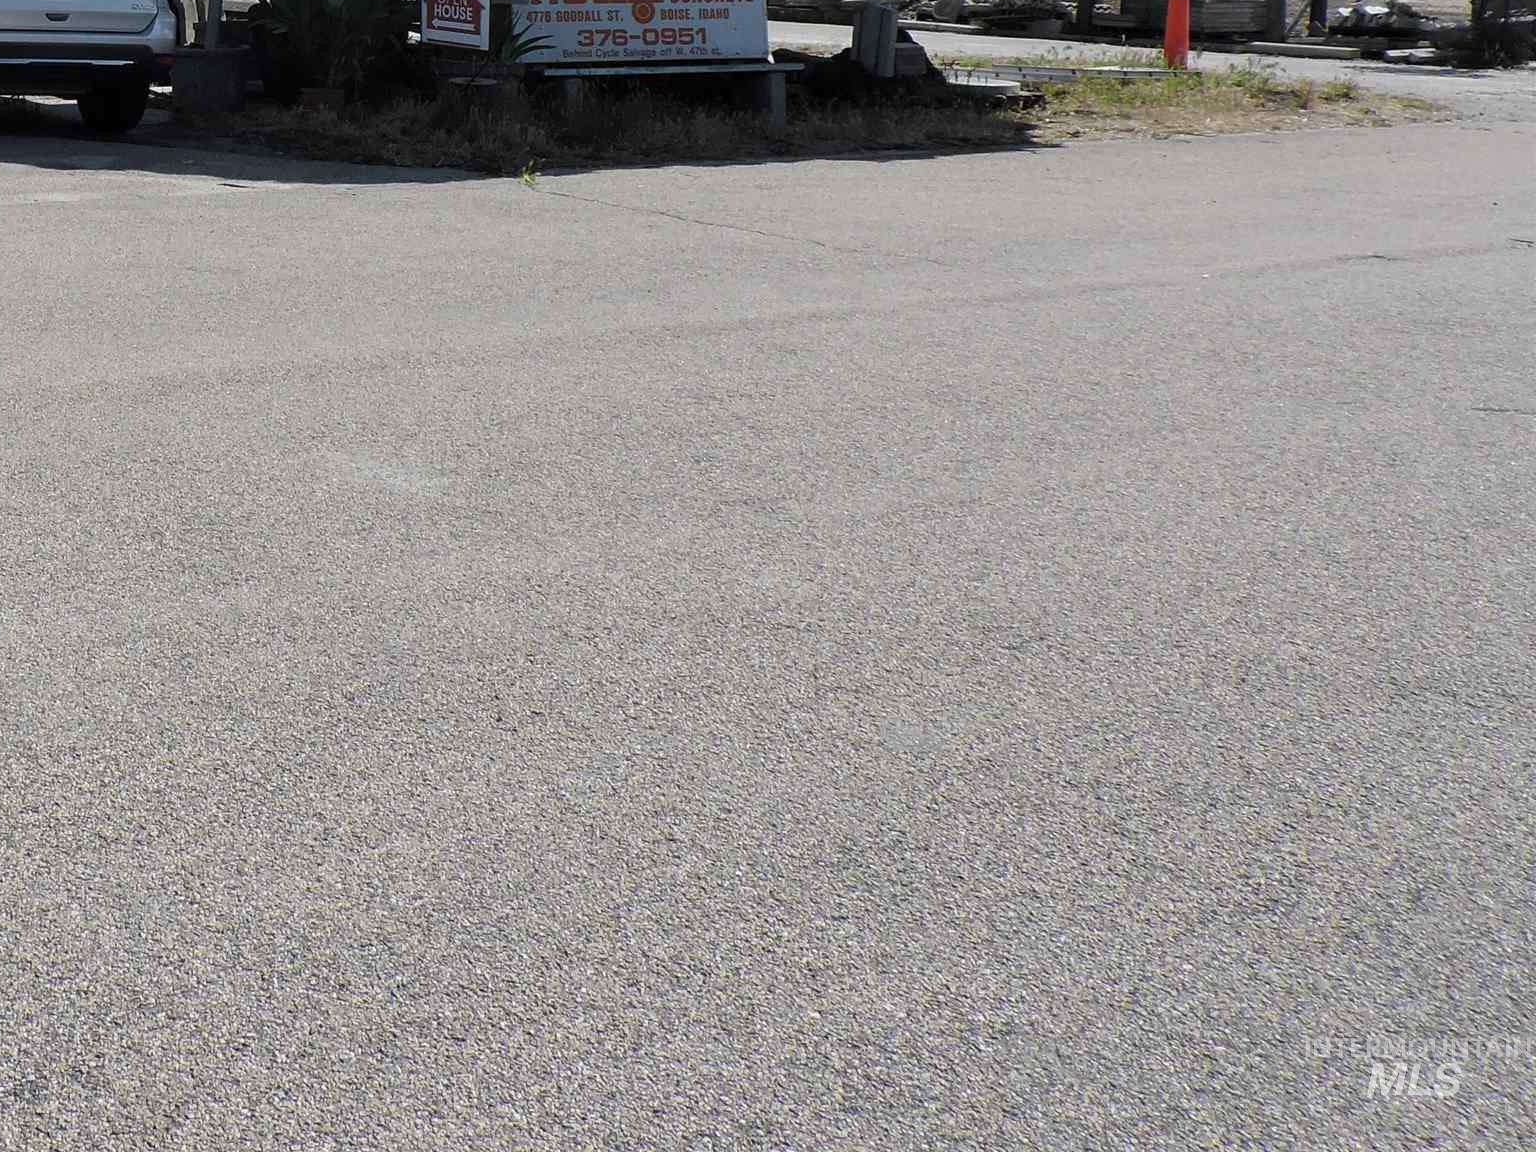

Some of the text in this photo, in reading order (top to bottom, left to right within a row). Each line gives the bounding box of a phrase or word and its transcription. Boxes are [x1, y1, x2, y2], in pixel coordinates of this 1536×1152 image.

[433, 4, 473, 21] HOUSE
[698, 8, 731, 21] IDAHO
[576, 28, 707, 48] 376-0951
